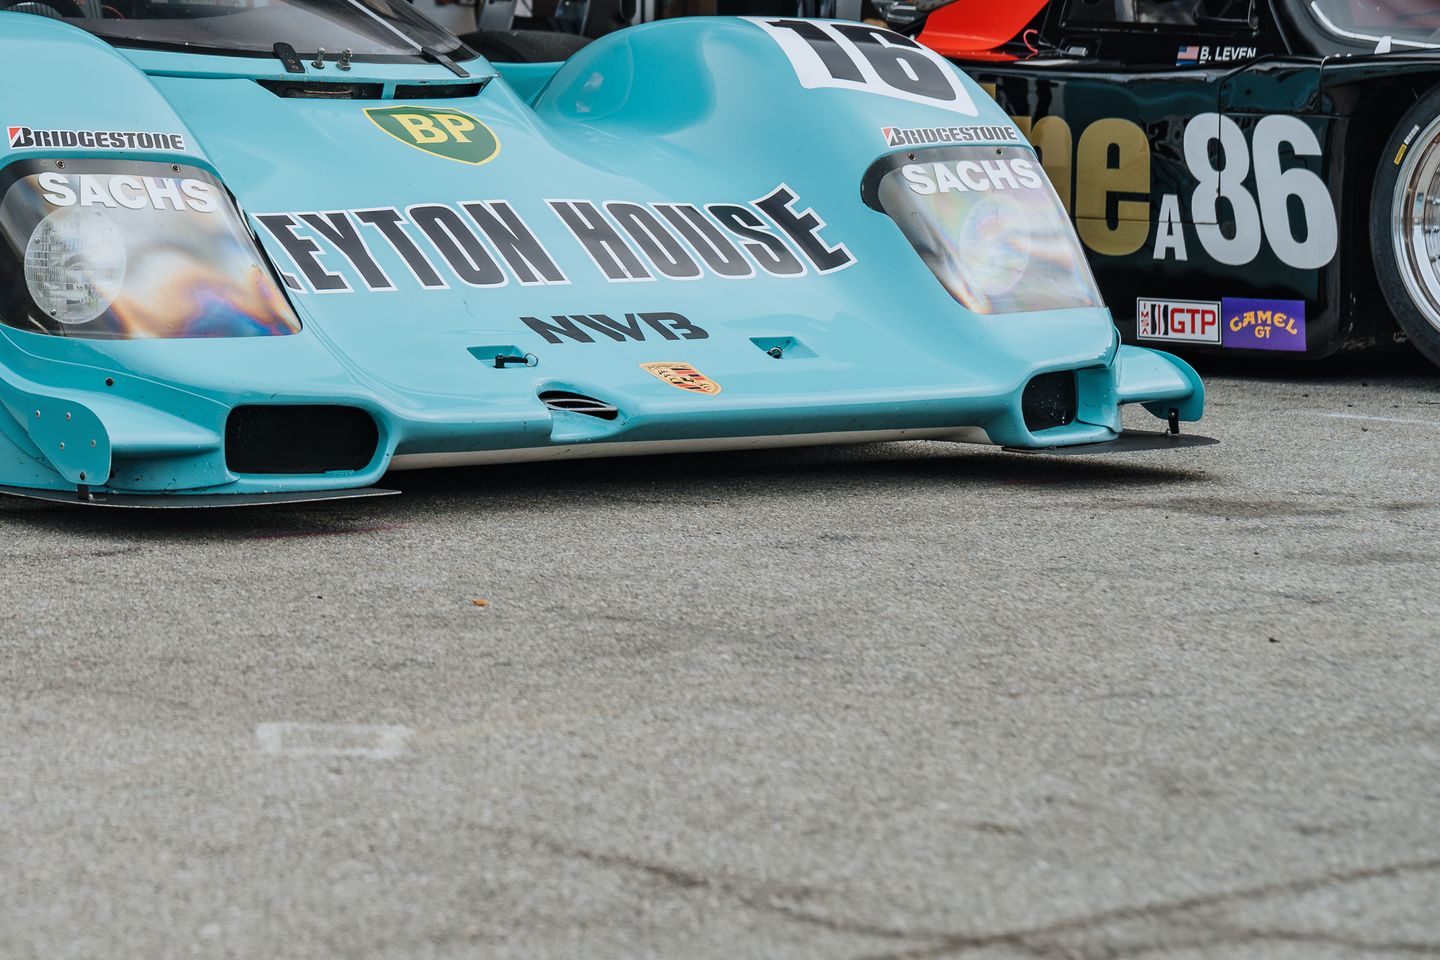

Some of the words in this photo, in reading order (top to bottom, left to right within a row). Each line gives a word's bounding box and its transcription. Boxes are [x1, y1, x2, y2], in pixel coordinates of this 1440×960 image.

[763, 18, 957, 102] 16
[8, 126, 185, 150] BRIDGESTONE
[390, 113, 476, 144] BP
[881, 126, 1019, 147] BRIDGESTONE
[38, 171, 218, 214] SACHS
[901, 158, 1044, 196] SACHS
[1183, 111, 1339, 270] 86
[542, 182, 859, 281] HOUSE
[518, 311, 710, 345] NWB
[1169, 307, 1217, 337] GTP
[1229, 310, 1298, 335] CAMEL
[1254, 326, 1271, 340] GT
